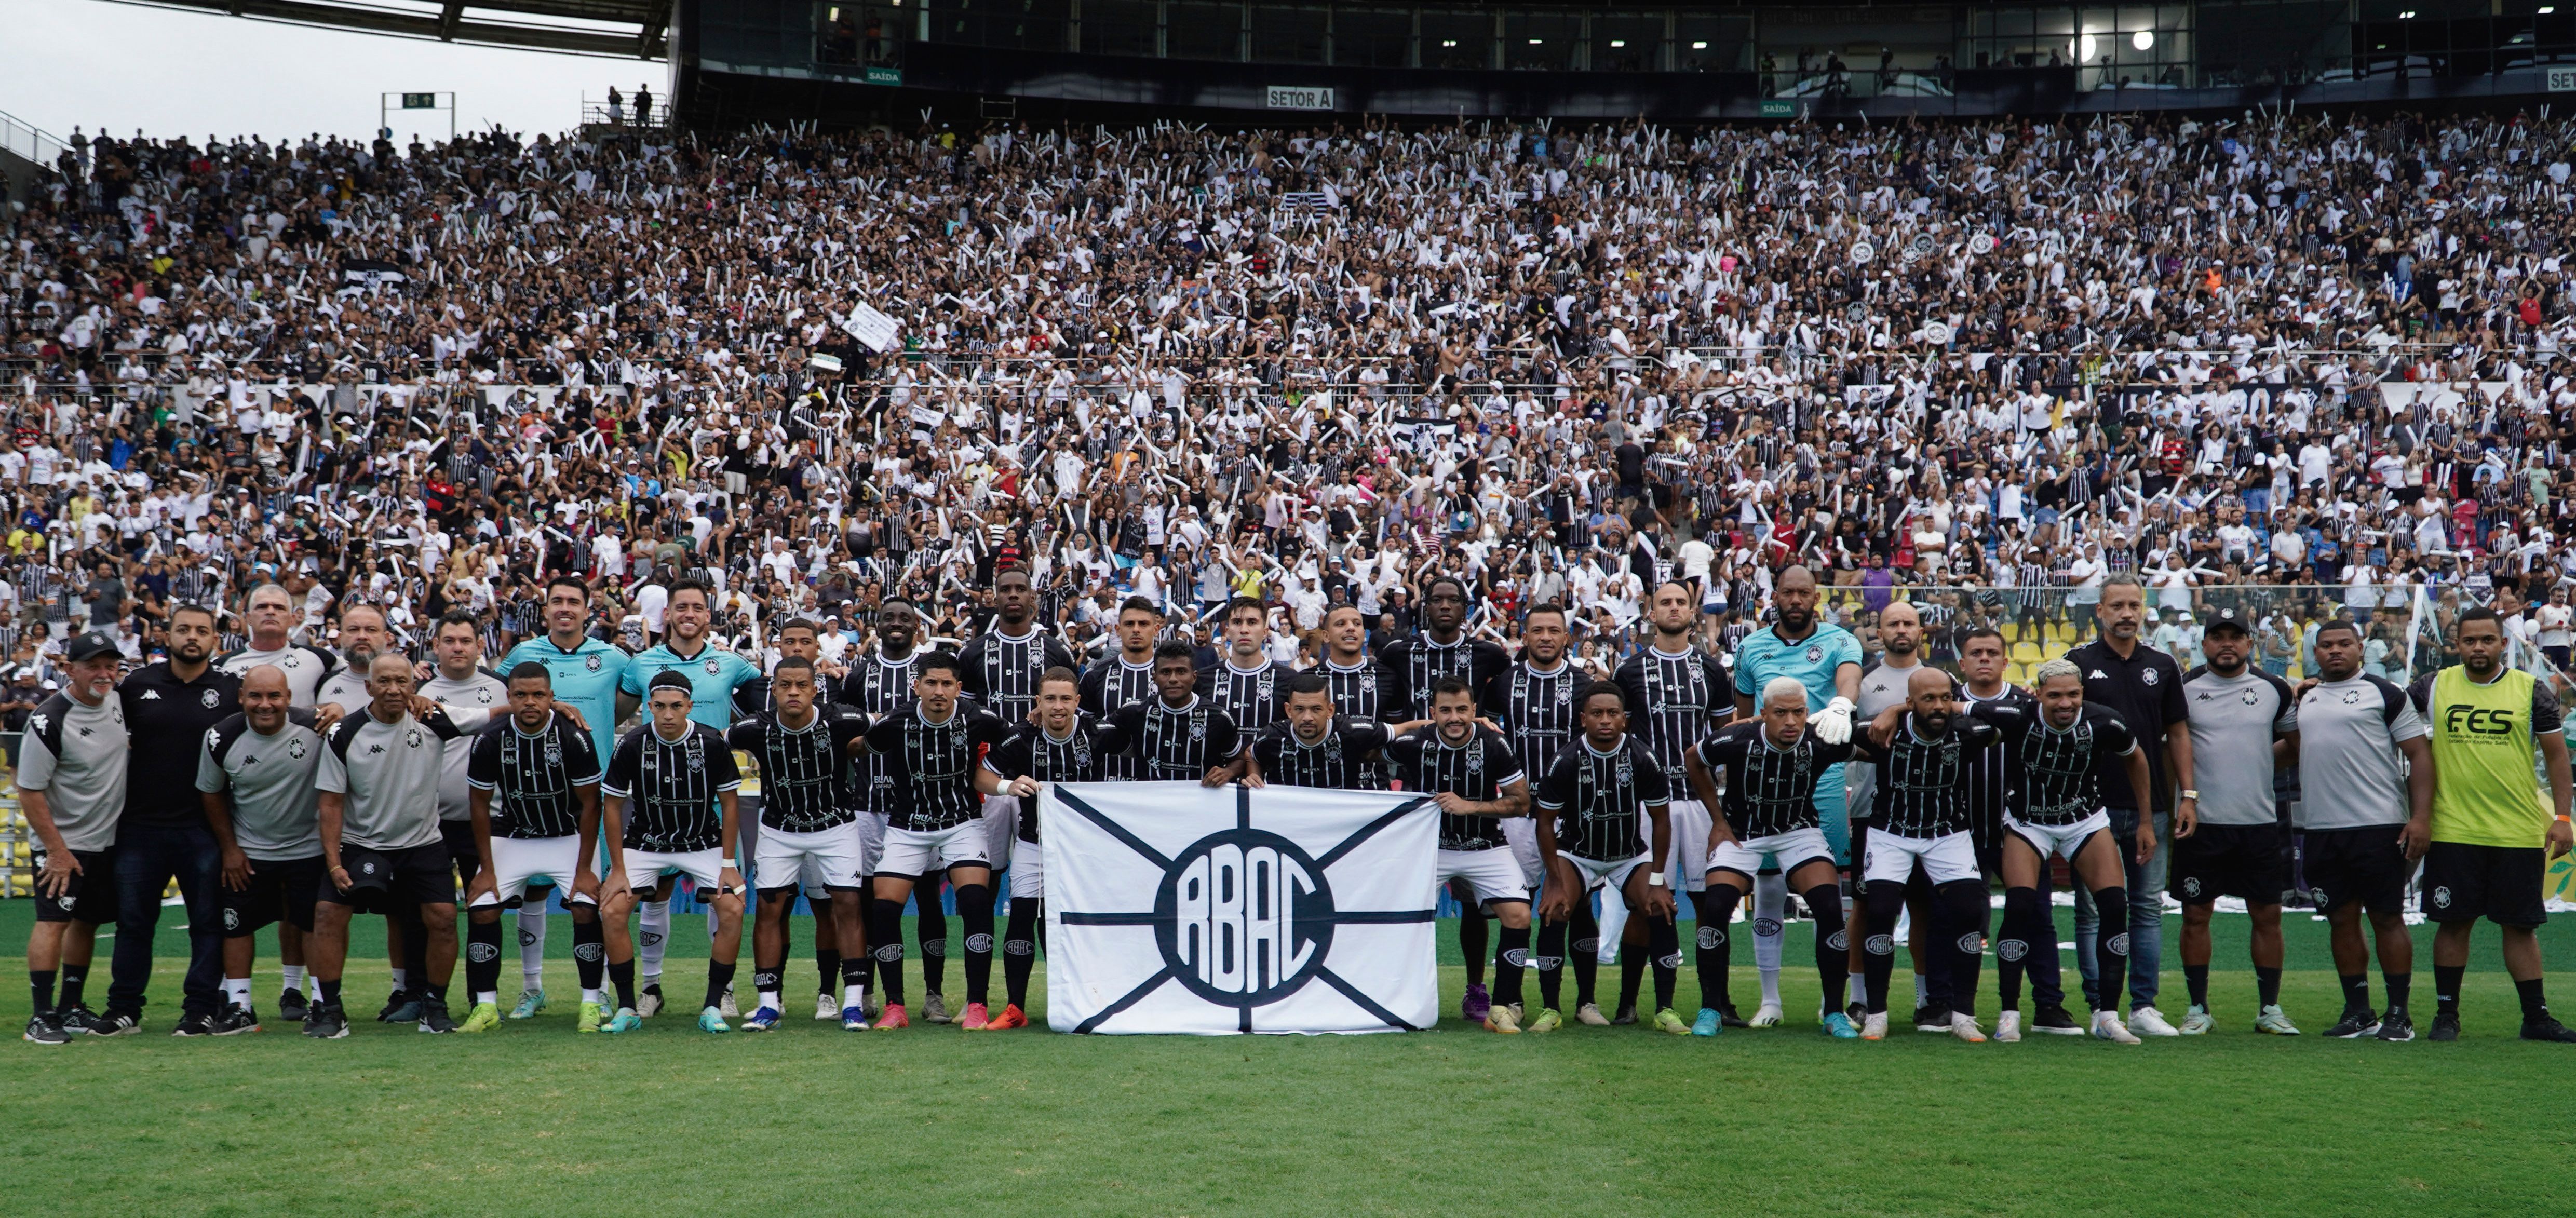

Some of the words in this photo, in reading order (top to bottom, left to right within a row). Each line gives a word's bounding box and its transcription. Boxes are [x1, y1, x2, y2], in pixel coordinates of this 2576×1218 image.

[869, 72, 898, 81] SAÍDA
[1271, 91, 1315, 106] SETOR
[1319, 90, 1330, 107] A
[1763, 104, 1791, 113] SAÍDA
[2444, 705, 2514, 734] FES
[1177, 843, 1316, 994] RBAC
[1755, 919, 1777, 935] RBAC
[970, 935, 993, 951] RBAC
[1698, 928, 1720, 947] RBAC
[1870, 937, 1893, 952] RBAC
[578, 944, 602, 959] RBAC
[879, 946, 903, 960] RBAC
[1007, 941, 1033, 953] RBAC
[2000, 941, 2024, 960] RBAC
[1537, 958, 1557, 969] RBAC
